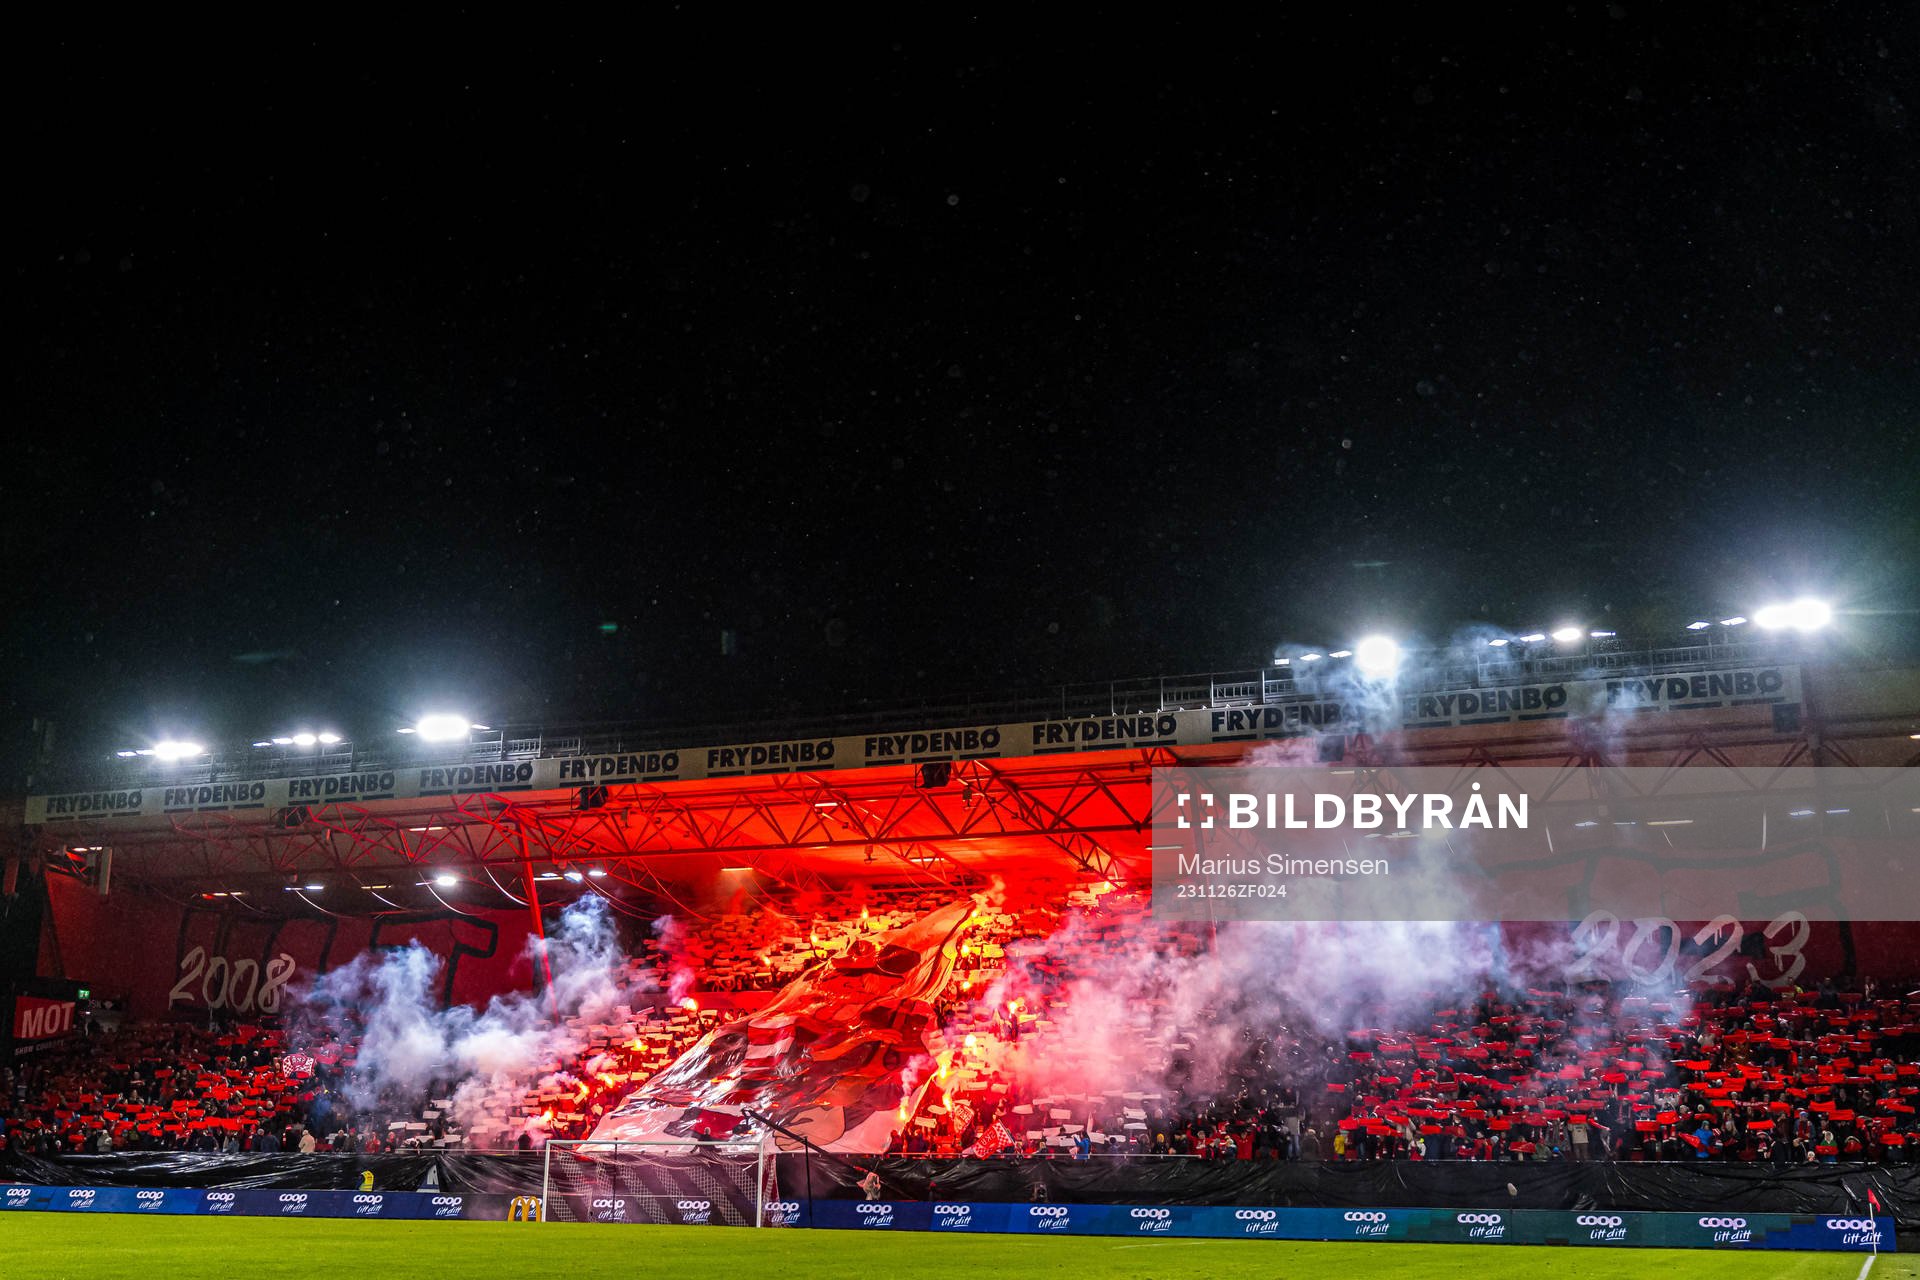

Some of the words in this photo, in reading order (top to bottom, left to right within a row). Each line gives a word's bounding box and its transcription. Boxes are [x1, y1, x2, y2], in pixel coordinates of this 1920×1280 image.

[1565, 910, 1810, 986] 2023
[169, 946, 296, 1015] 2008
[22, 1002, 76, 1038] MOT
[7, 1189, 31, 1197] coop
[69, 1190, 95, 1198] coop
[137, 1191, 164, 1200] coop
[207, 1193, 235, 1202] coop
[279, 1194, 307, 1203] coop
[353, 1195, 383, 1204] coop
[432, 1197, 462, 1206] coop
[593, 1199, 625, 1209] coop
[678, 1200, 710, 1211] coop
[765, 1202, 799, 1213] coop
[856, 1204, 892, 1215] coop
[934, 1205, 970, 1216] coop
[1030, 1207, 1067, 1218] coop
[1131, 1209, 1170, 1220] coop
[1235, 1210, 1276, 1222] coop
[1344, 1212, 1386, 1223] coop
[1457, 1214, 1501, 1226] coop
[1577, 1216, 1622, 1228] coop
[1699, 1218, 1746, 1230] coop
[1827, 1220, 1876, 1232] coop
